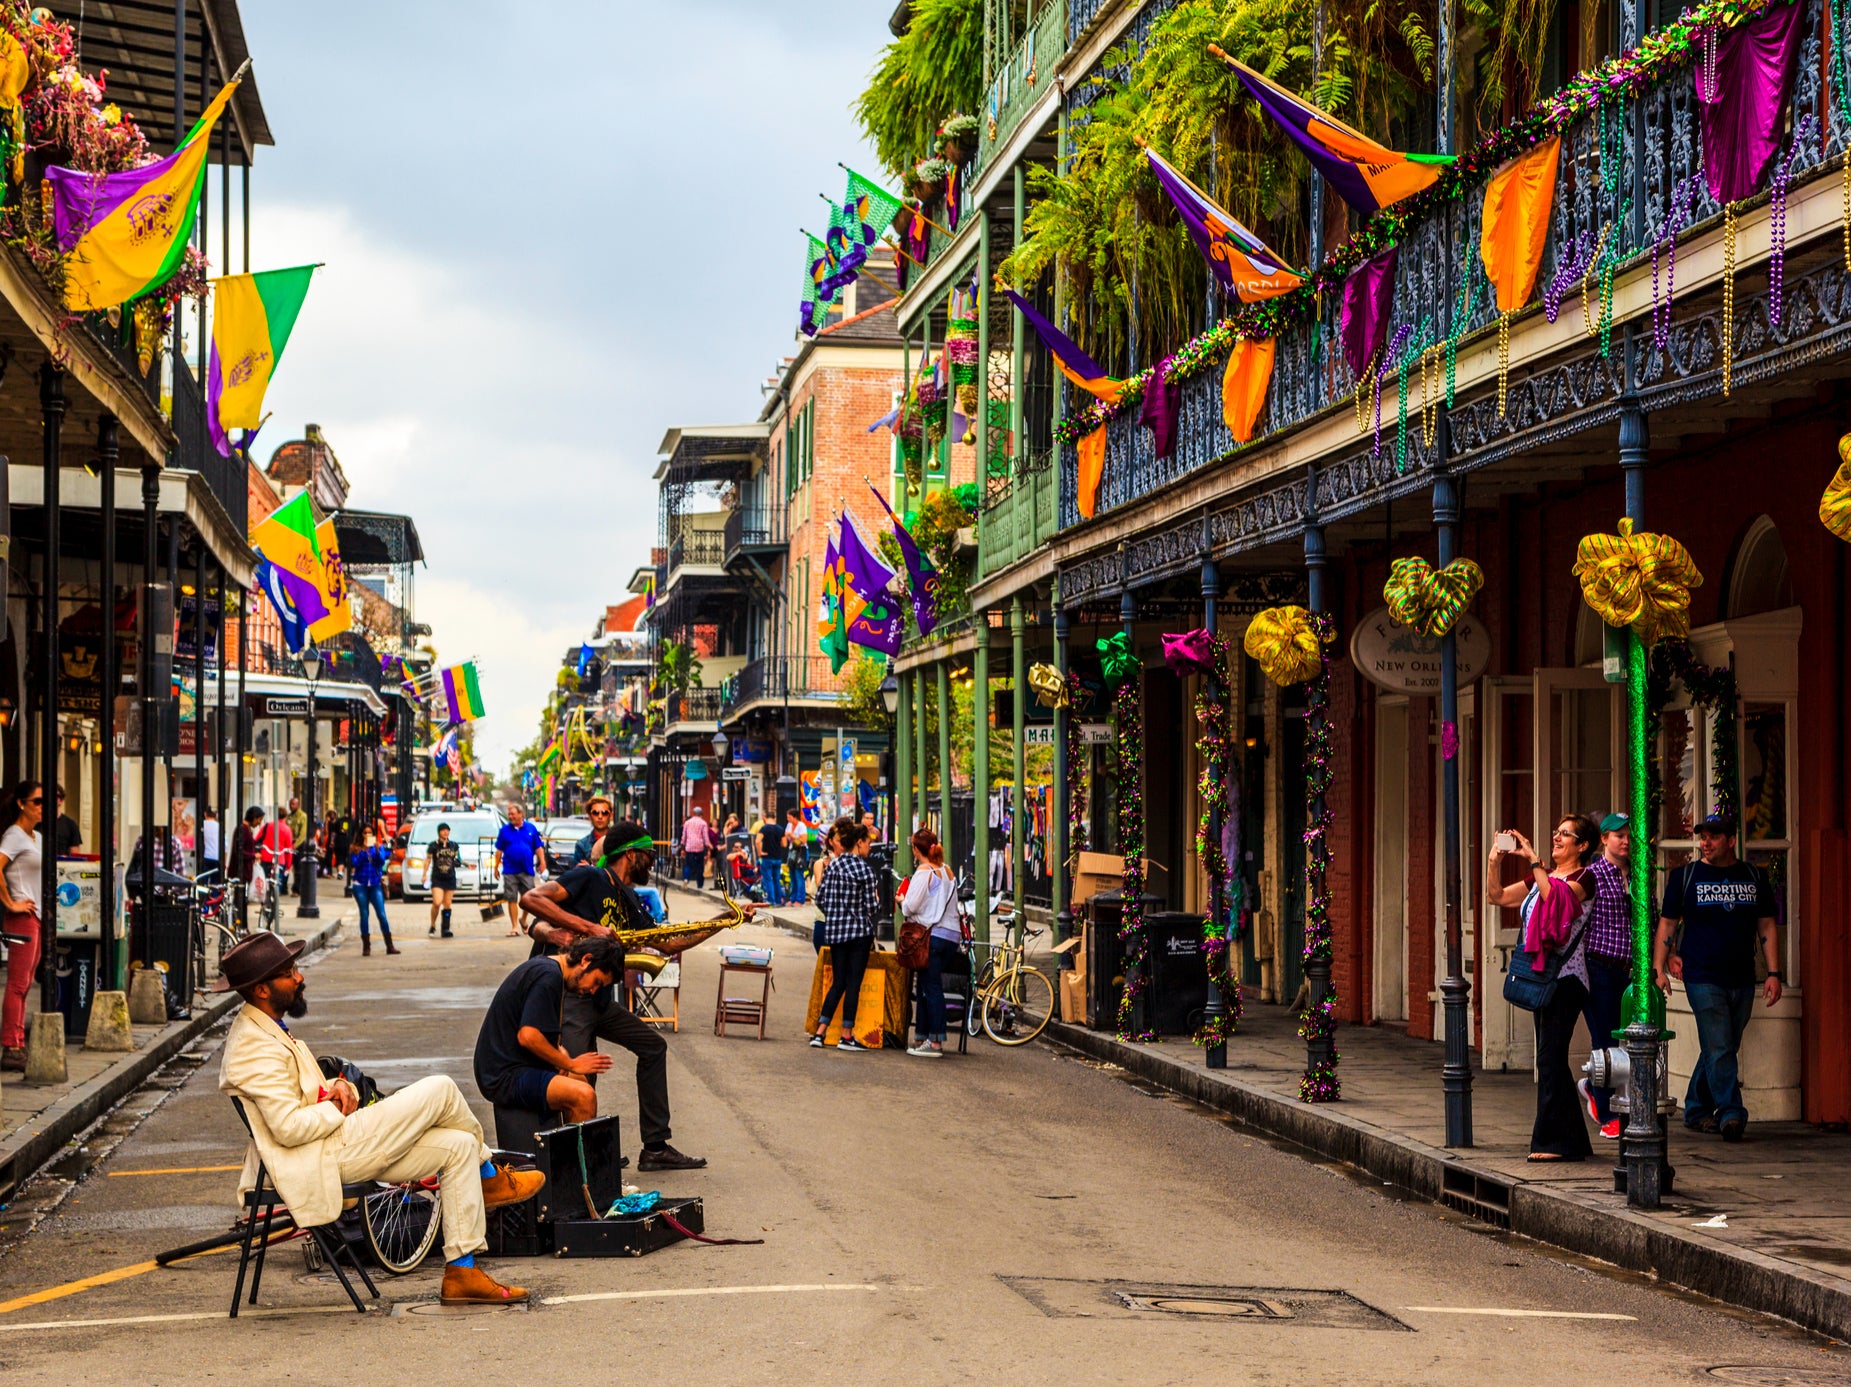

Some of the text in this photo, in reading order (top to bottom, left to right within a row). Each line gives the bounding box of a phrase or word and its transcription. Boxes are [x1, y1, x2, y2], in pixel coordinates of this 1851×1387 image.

[1375, 660, 1406, 672] NEW
[270, 702, 306, 712] Orleans
[1091, 731, 1111, 742] Trade
[1696, 884, 1757, 895] SPORTING
[1697, 893, 1757, 903] KANSAS CITY
